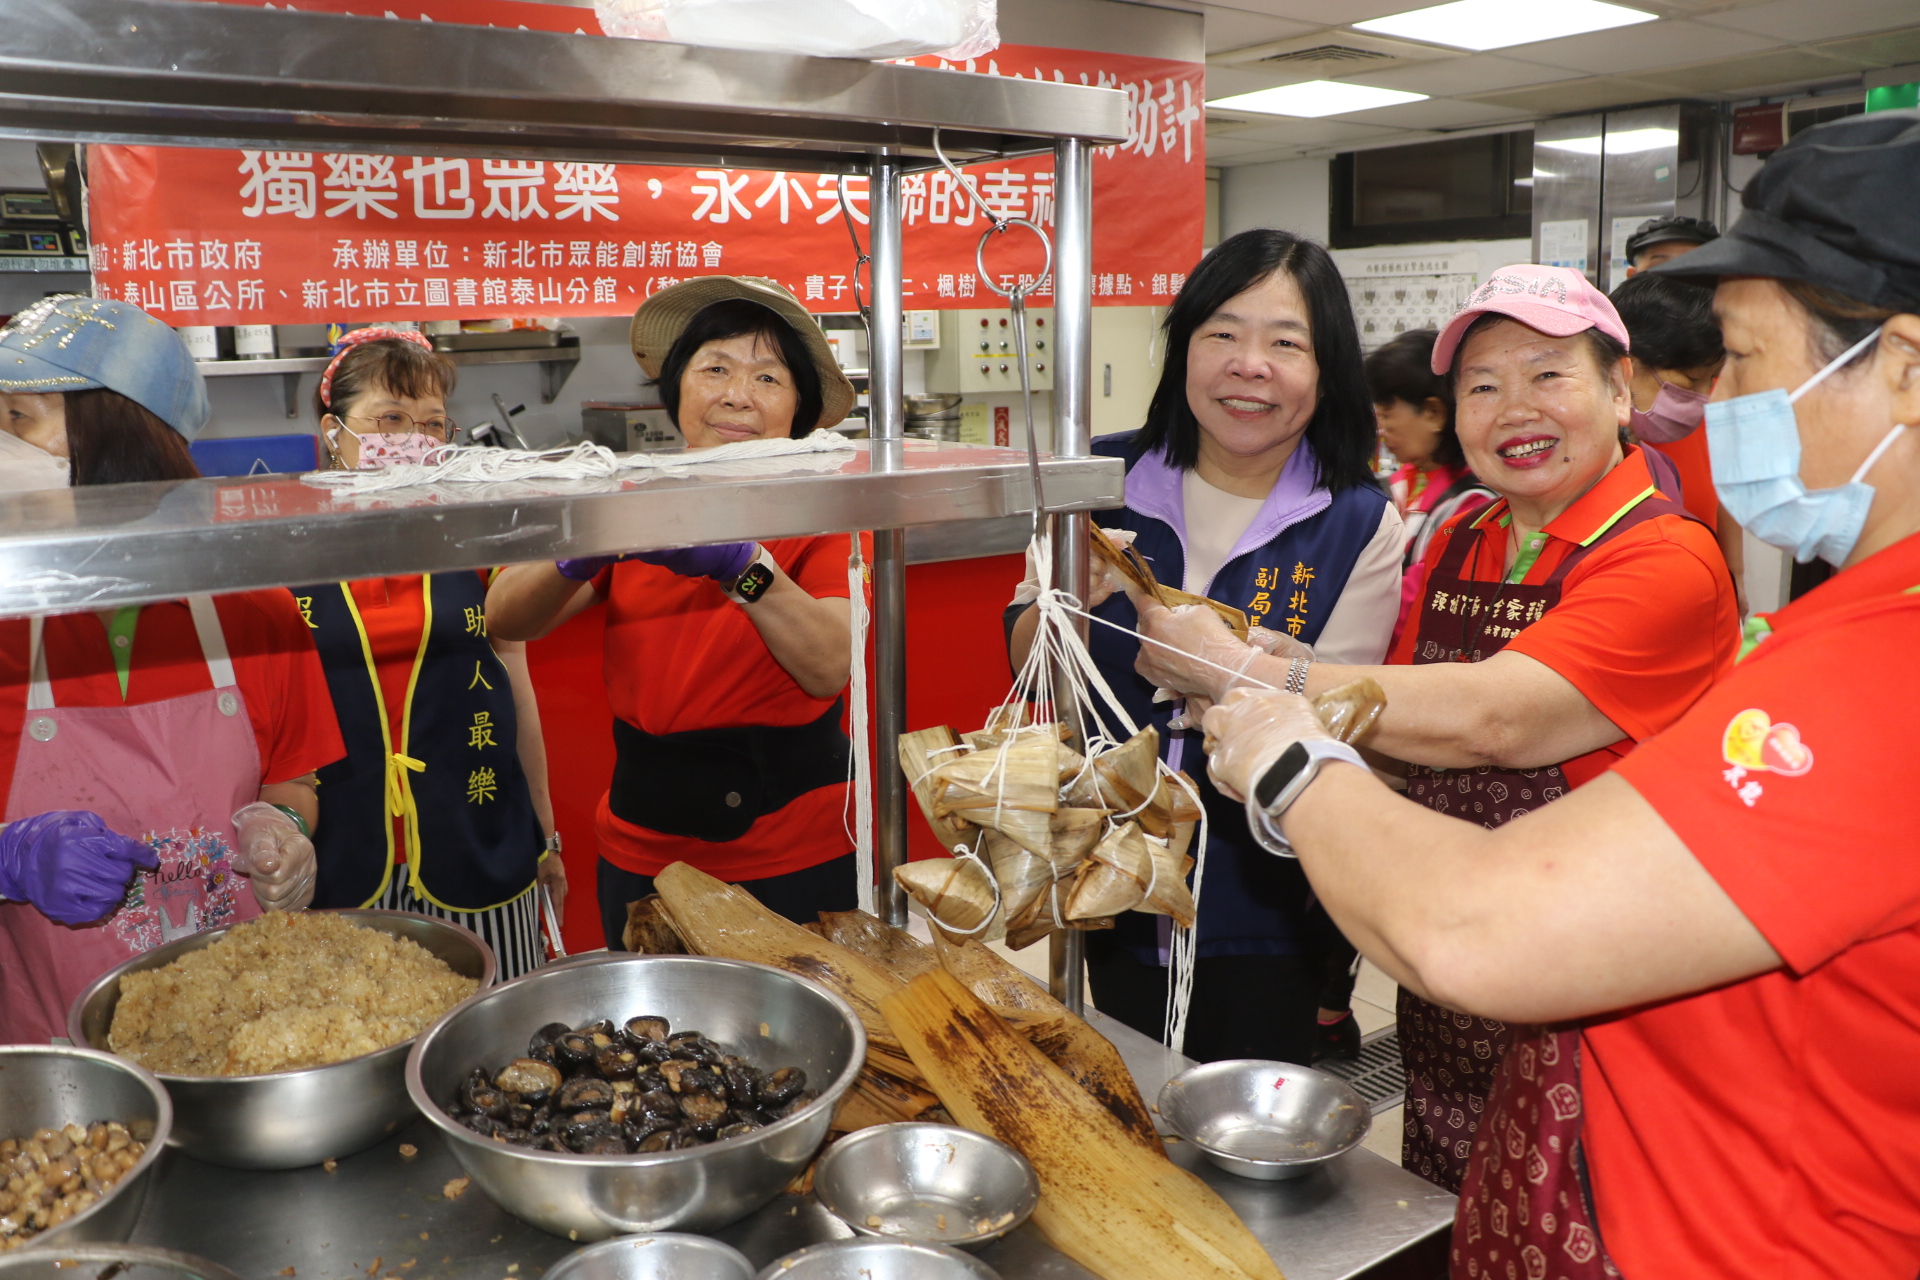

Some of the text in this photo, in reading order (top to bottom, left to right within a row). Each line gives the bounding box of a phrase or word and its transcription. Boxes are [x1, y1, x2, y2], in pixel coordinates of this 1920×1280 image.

[332, 239, 723, 270] 承辦單位：新北市眾能創新協會
[1286, 561, 1316, 638] 新北市
[463, 604, 498, 805] 助人最樂
